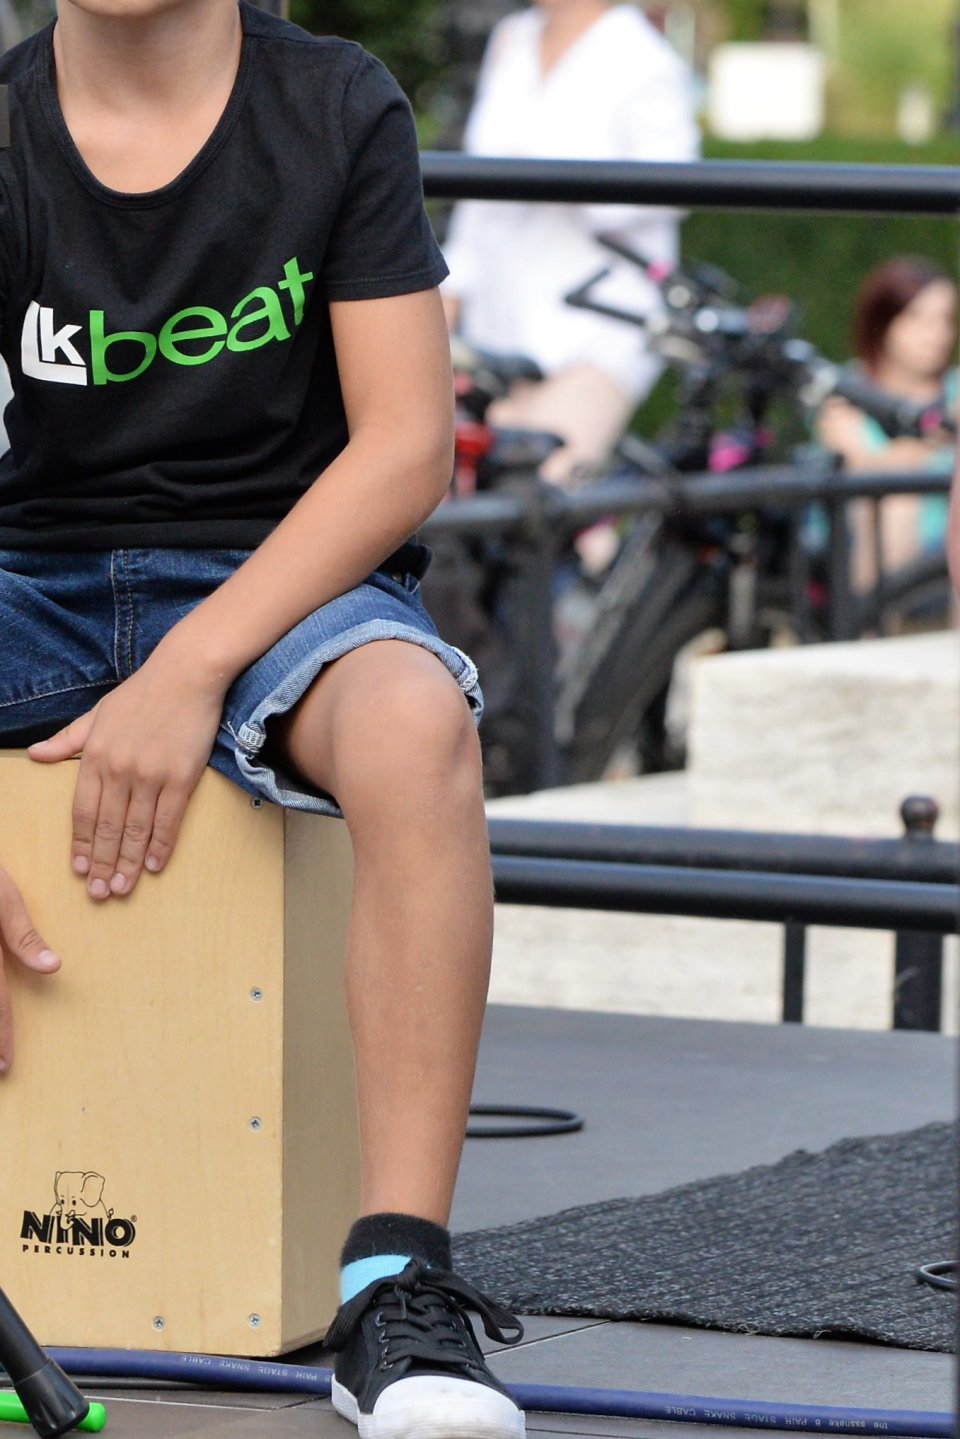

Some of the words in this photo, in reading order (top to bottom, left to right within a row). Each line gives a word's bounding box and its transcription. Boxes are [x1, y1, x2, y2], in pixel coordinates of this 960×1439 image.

[20, 1210, 136, 1247] NINO
[22, 1244, 130, 1259] PERCUSSION
[218, 1361, 251, 1372] SNAKE
[257, 1365, 289, 1377] STAGE
[295, 1370, 318, 1382] PAIR
[664, 1404, 697, 1417] CABLE
[704, 1409, 737, 1421] SNAKE
[743, 1412, 778, 1424] STAGE
[784, 1416, 809, 1427] PAIR
